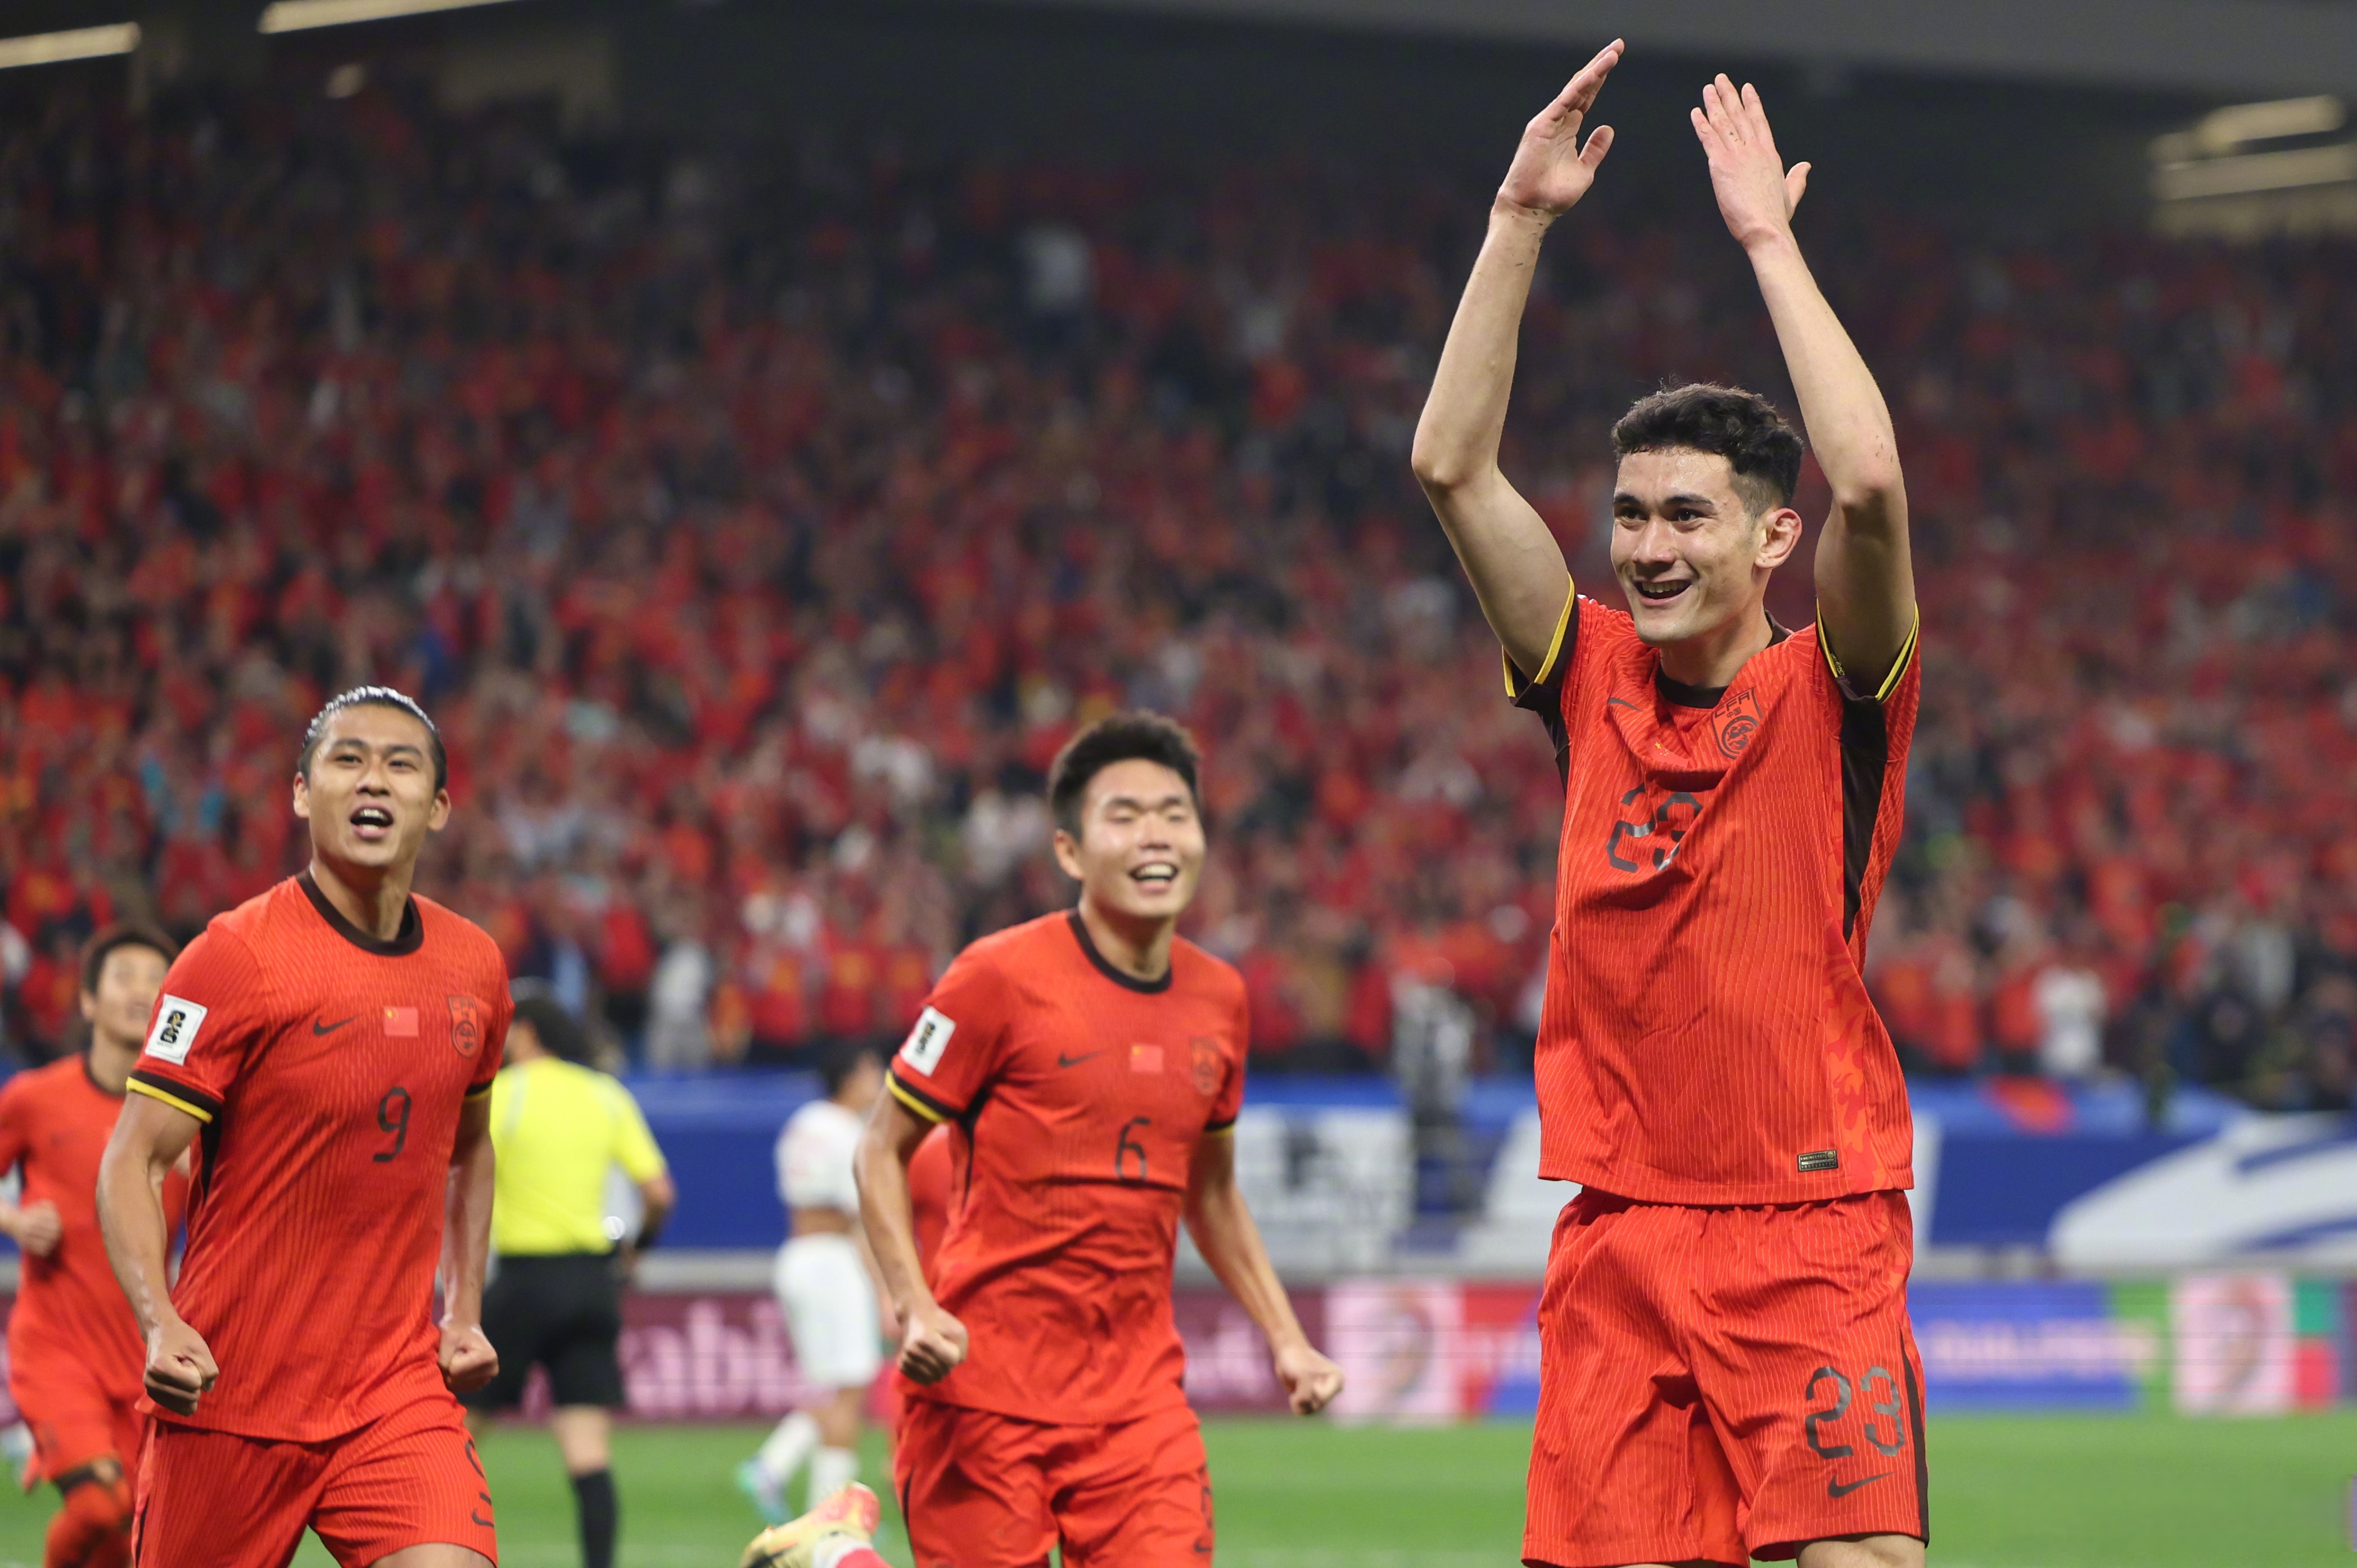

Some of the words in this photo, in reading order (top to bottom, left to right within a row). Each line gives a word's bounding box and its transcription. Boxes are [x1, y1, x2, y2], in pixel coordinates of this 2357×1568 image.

[1714, 692, 1750, 718] CFA
[1606, 782, 1704, 873] 23
[373, 1086, 412, 1162] 9
[1115, 1117, 1151, 1182] 6
[1805, 1366, 1905, 1459] 23
